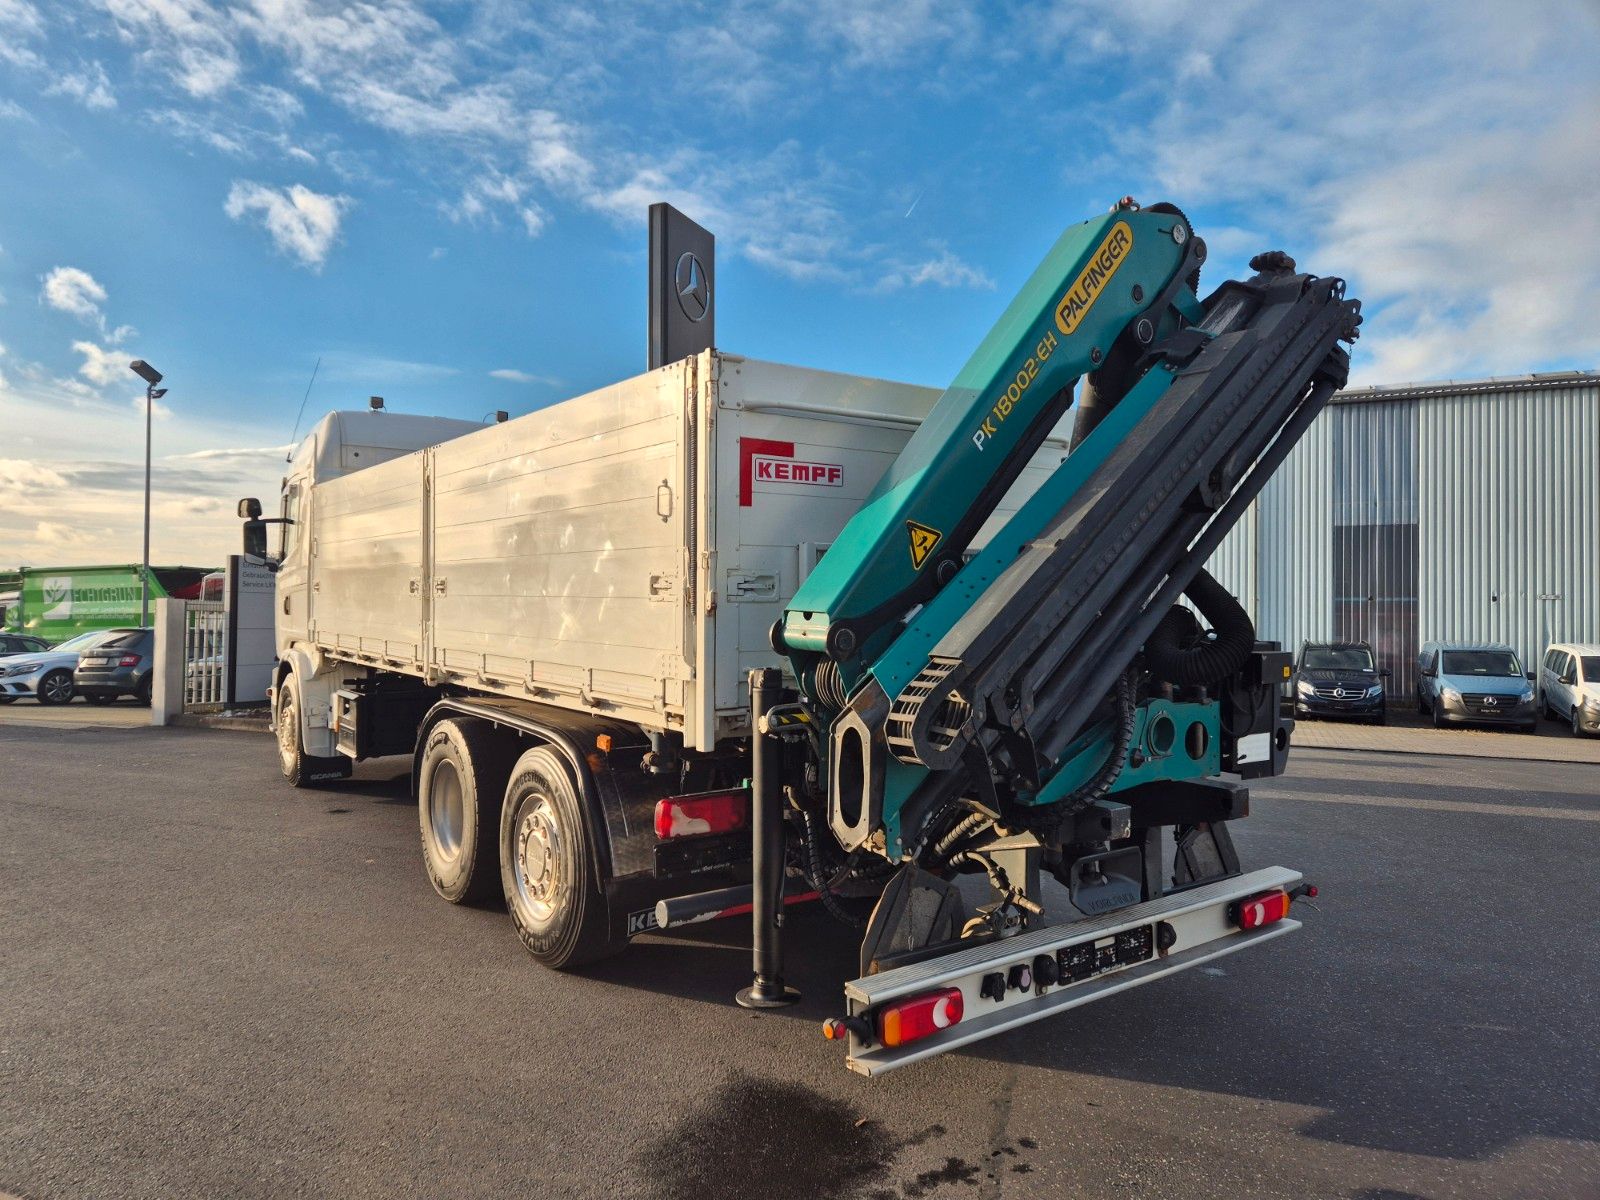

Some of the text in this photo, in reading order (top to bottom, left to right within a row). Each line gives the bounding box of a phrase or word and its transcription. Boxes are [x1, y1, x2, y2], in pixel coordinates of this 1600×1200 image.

[1059, 227, 1129, 328] PALFINGER
[972, 417, 997, 452] PK
[758, 462, 841, 483] KEMPF
